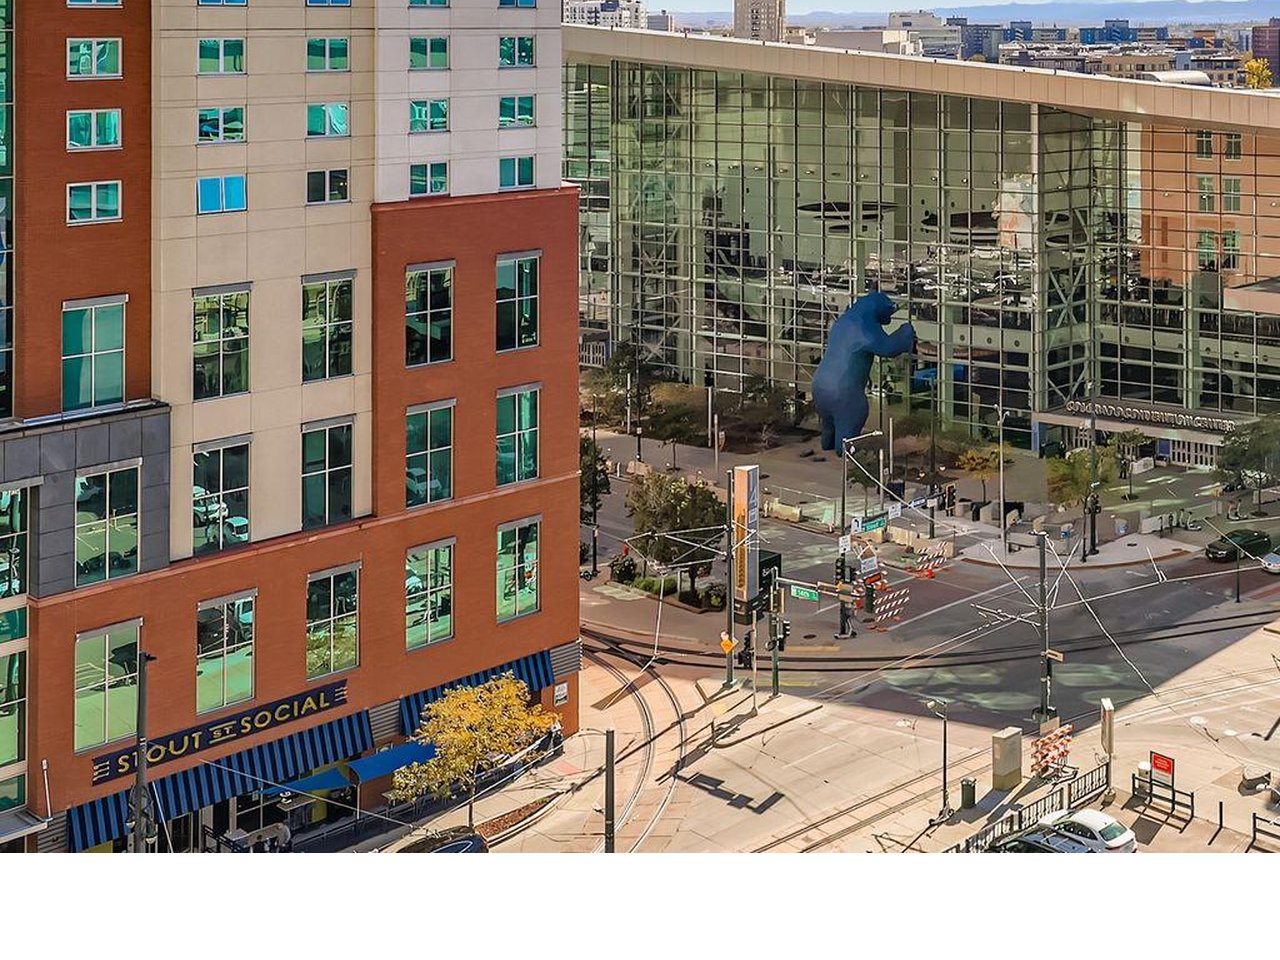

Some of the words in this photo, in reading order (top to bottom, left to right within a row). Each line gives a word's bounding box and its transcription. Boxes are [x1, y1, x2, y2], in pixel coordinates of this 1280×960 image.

[117, 731, 203, 773] STOUT
[212, 725, 233, 739] ST
[240, 692, 330, 734] SOCIAL
